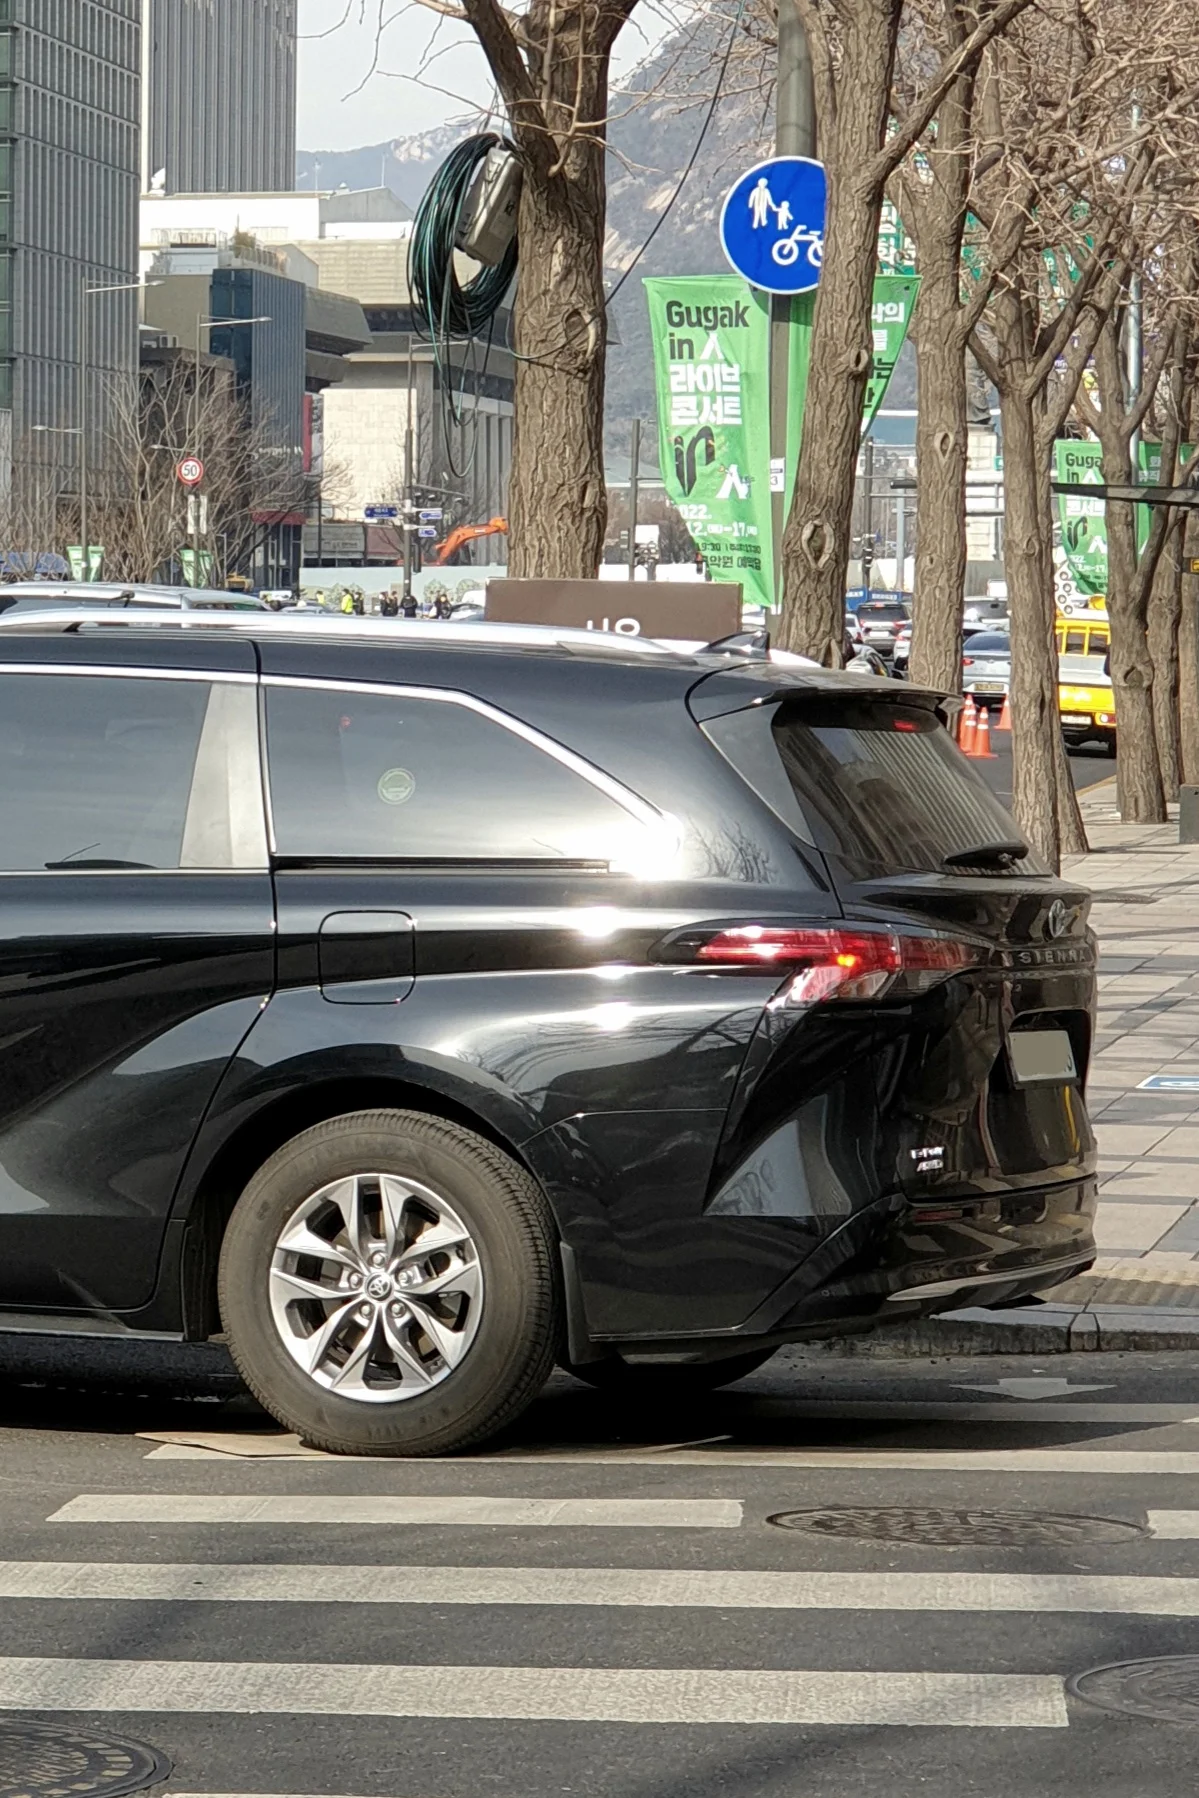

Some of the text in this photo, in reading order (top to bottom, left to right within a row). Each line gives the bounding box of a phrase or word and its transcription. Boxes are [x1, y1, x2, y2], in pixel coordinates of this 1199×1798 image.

[666, 300, 752, 332] Gugak
[668, 332, 695, 360] in
[669, 363, 742, 393] 라이브
[671, 395, 743, 426] 콘서트
[183, 464, 198, 477] 50
[1065, 452, 1103, 468] Guga
[1066, 468, 1080, 483] in
[1019, 949, 1086, 964] SIENNA
